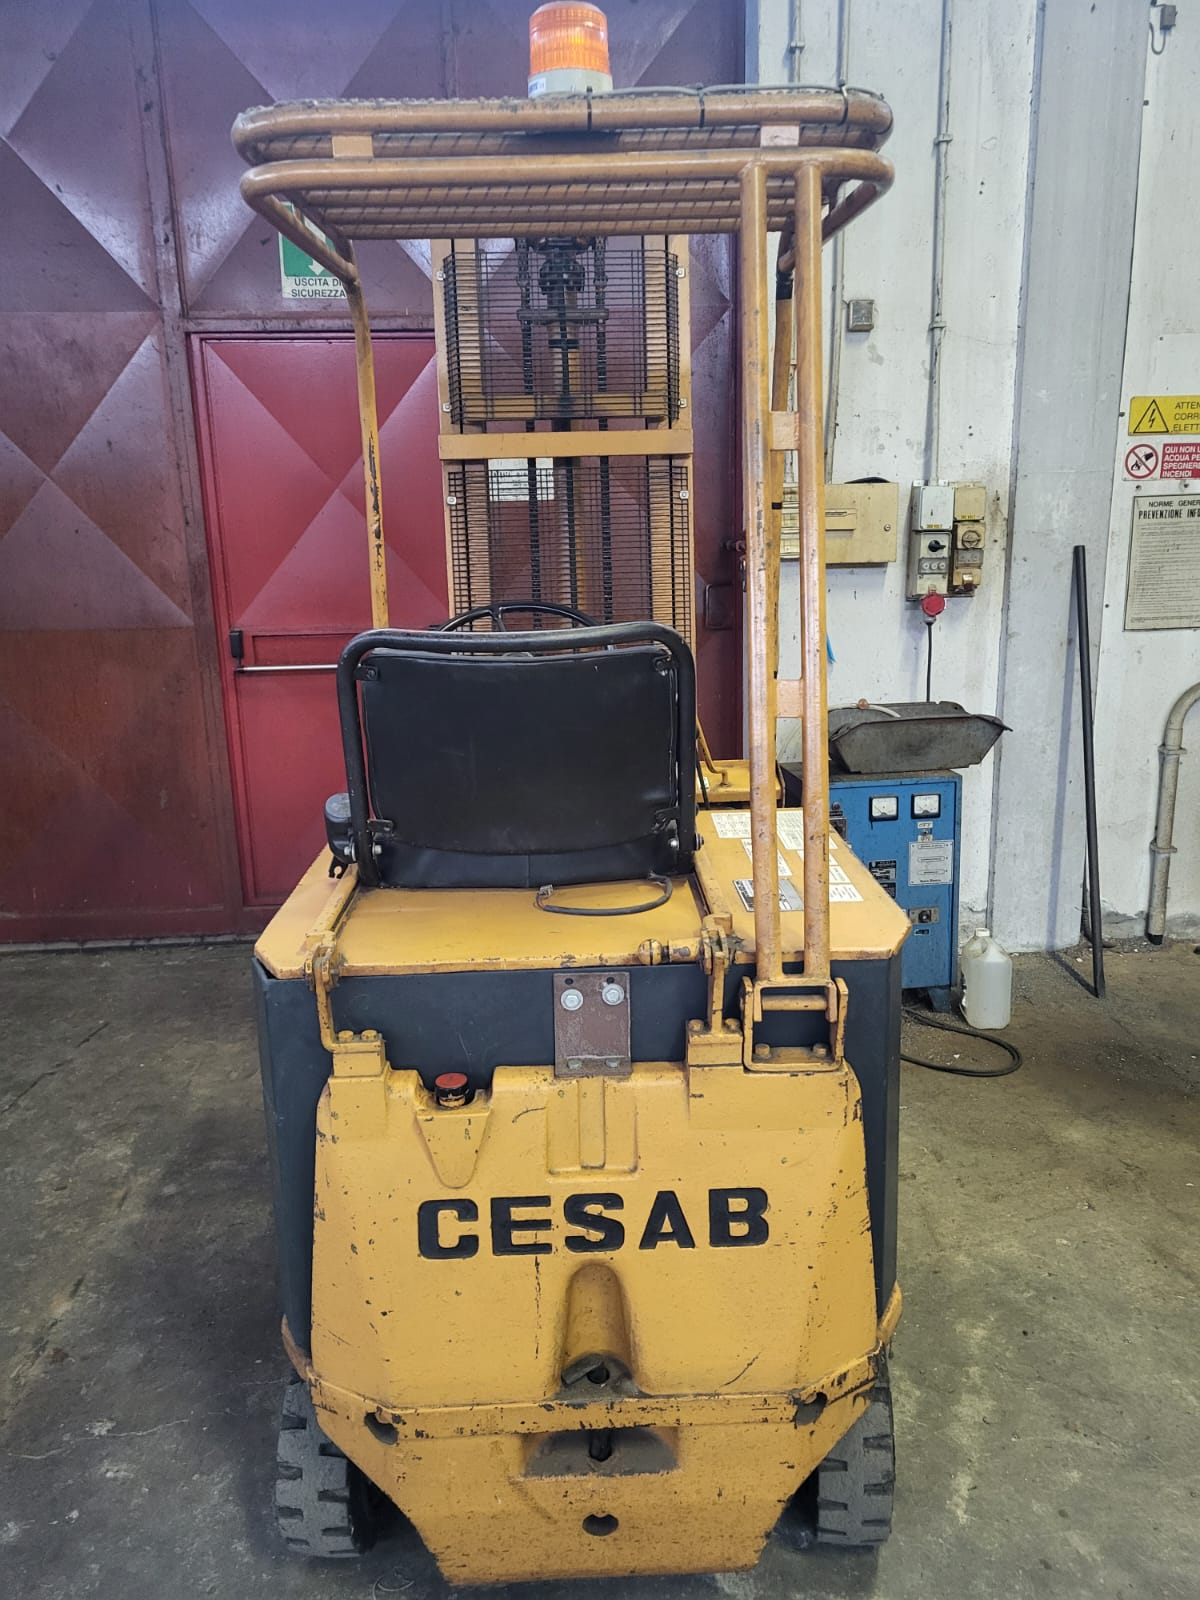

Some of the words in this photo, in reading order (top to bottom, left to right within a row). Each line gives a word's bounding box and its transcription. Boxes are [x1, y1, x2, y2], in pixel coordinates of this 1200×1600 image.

[294, 278, 329, 286] USCITA
[291, 288, 346, 297] SICUREZZA
[1165, 445, 1178, 454] QUI
[1179, 445, 1196, 453] NON
[1162, 470, 1193, 478] INCENDI
[1148, 500, 1174, 508] NORME
[1138, 508, 1183, 520] PREVENZIONE
[417, 1186, 770, 1260] CESAB
